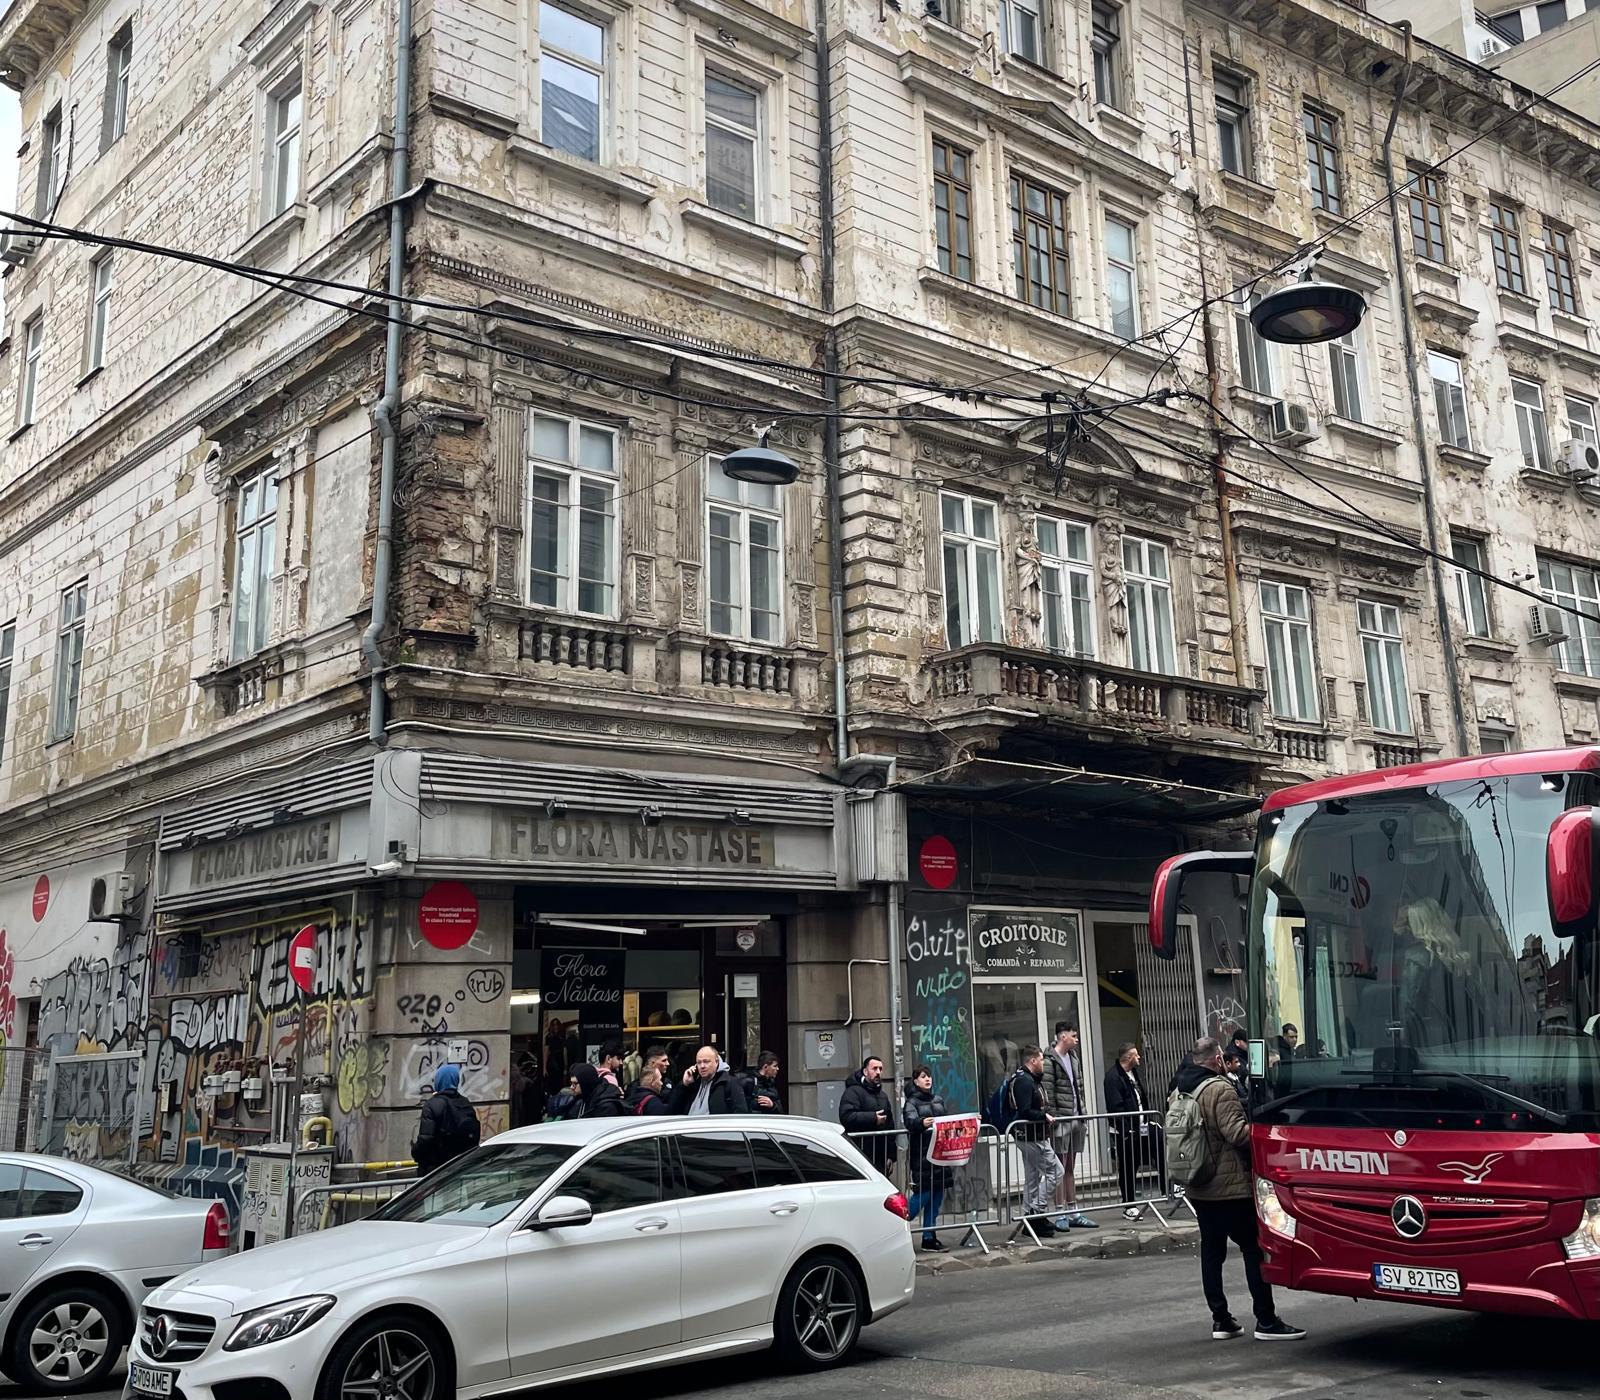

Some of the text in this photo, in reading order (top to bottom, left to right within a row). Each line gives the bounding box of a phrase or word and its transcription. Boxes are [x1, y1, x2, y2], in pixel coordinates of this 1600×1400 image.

[509, 815, 762, 864] FLORA NASTASE
[197, 821, 331, 885] FLORA NASTASE
[979, 923, 1068, 948] CROITORIE
[553, 953, 609, 978] Flora
[986, 956, 1021, 968] COMANDĂ
[544, 976, 621, 1005] Năstase
[1296, 1148, 1390, 1176] TARSIN
[1432, 1196, 1495, 1206] TOURISMO
[1382, 1268, 1402, 1285] SV
